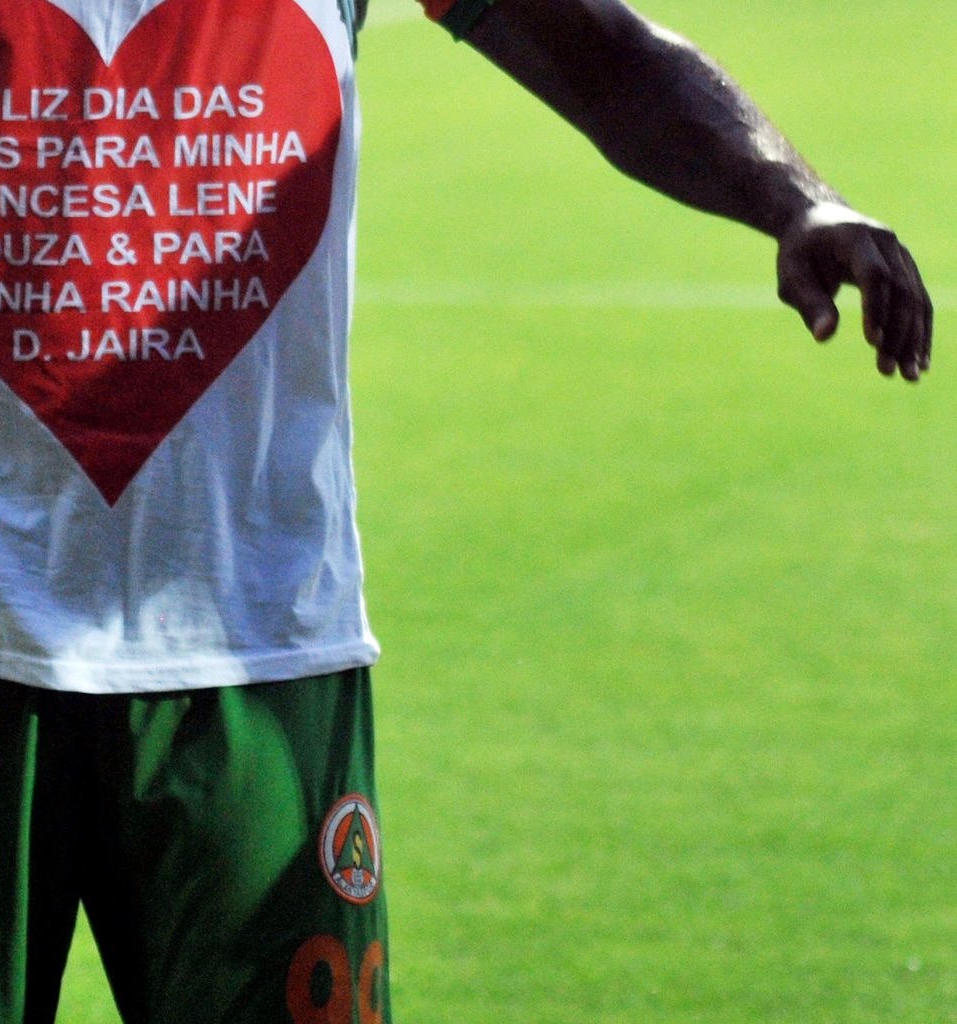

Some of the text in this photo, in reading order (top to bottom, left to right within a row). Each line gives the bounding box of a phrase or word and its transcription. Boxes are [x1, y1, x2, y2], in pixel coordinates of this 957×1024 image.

[83, 86, 159, 121] DIA
[173, 84, 265, 119] DAS
[36, 135, 160, 169] PARA
[173, 130, 307, 166] MINHA
[169, 179, 277, 216] LENE
[106, 231, 137, 266] &
[153, 230, 269, 265] PARA
[101, 276, 269, 312] RAINHA
[12, 328, 205, 362] D. JAIRA
